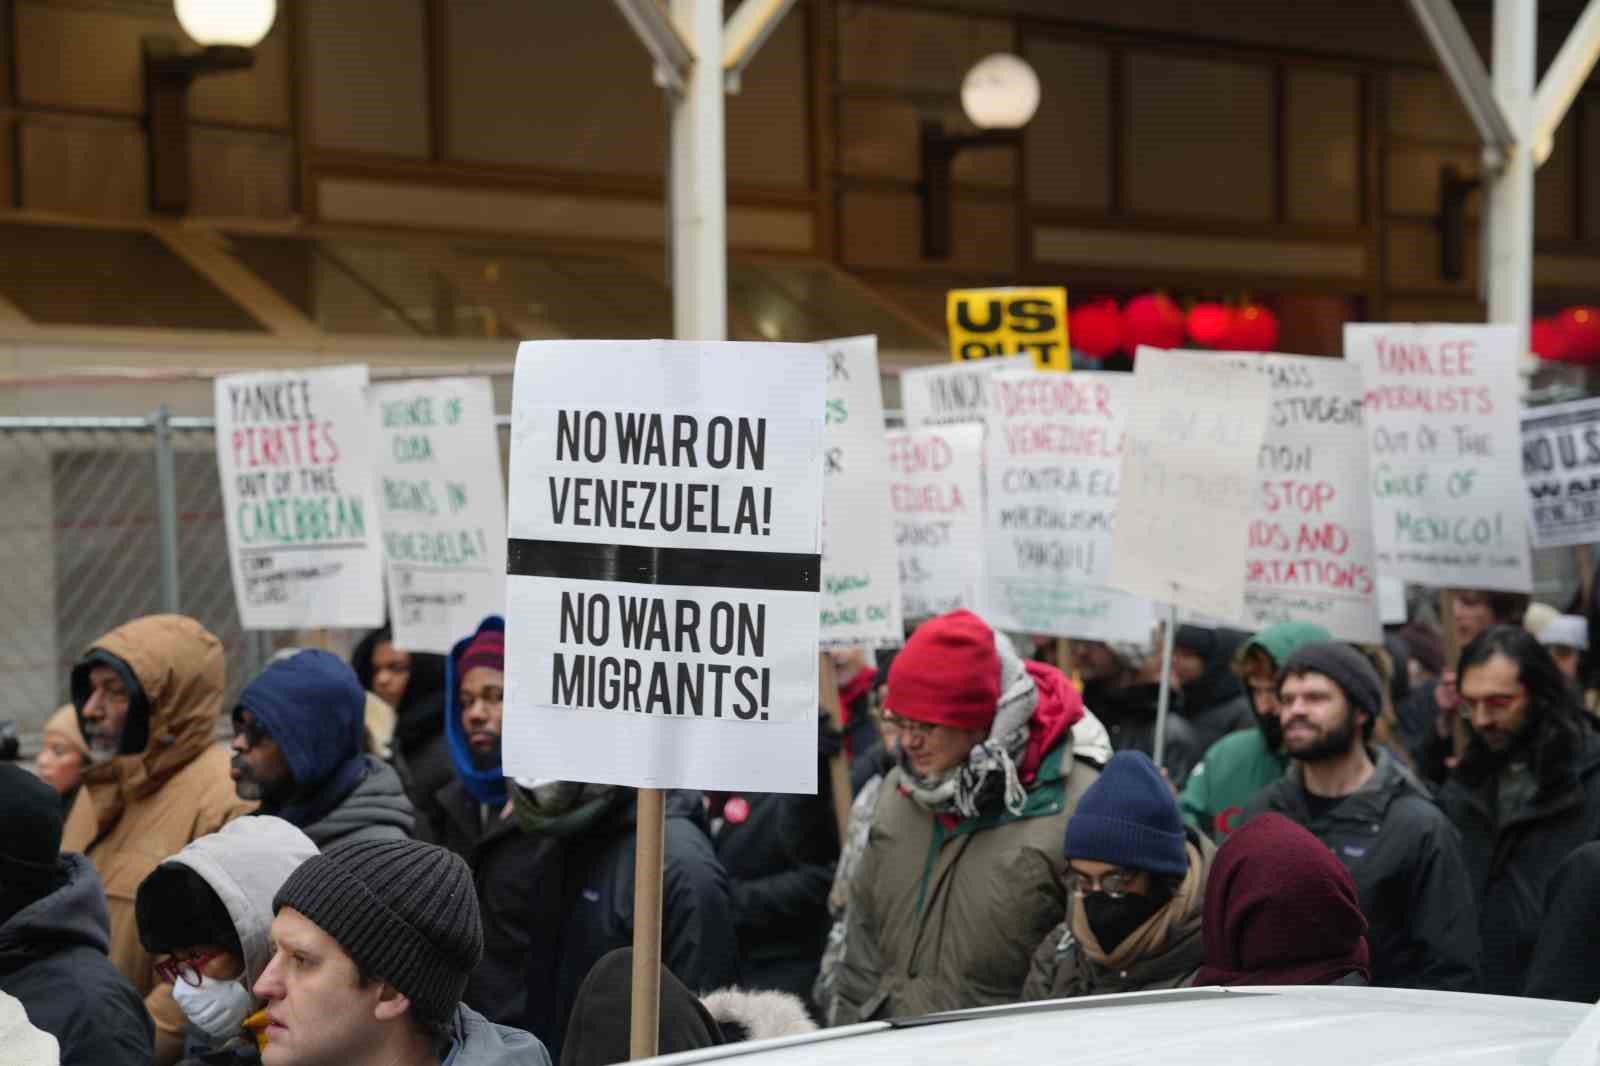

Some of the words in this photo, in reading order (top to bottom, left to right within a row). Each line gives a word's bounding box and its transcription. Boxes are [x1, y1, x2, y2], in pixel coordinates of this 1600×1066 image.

[957, 300, 1056, 334] US
[960, 342, 1059, 364] OT
[1375, 338, 1475, 377] YANKEE
[228, 379, 317, 421] YANKEE
[1272, 397, 1364, 427] STUDENT
[1361, 385, 1494, 415] MPERIALISTS
[233, 422, 341, 466] PIRATES
[556, 410, 607, 463] NO
[614, 412, 698, 468] WAR
[706, 416, 766, 471] ON
[887, 436, 953, 473] FEND
[1375, 426, 1409, 453] OUT
[300, 468, 339, 494] THE
[1262, 480, 1336, 514] STOP
[236, 498, 366, 543] CARIBBEAN
[549, 476, 773, 536] VENEZUELA!
[1297, 522, 1350, 555] AND
[1395, 512, 1504, 548] MEXICO!
[559, 591, 610, 647] NO
[618, 595, 700, 653] WAR
[709, 601, 766, 657] ON
[551, 653, 770, 721] MIGRANTS!
